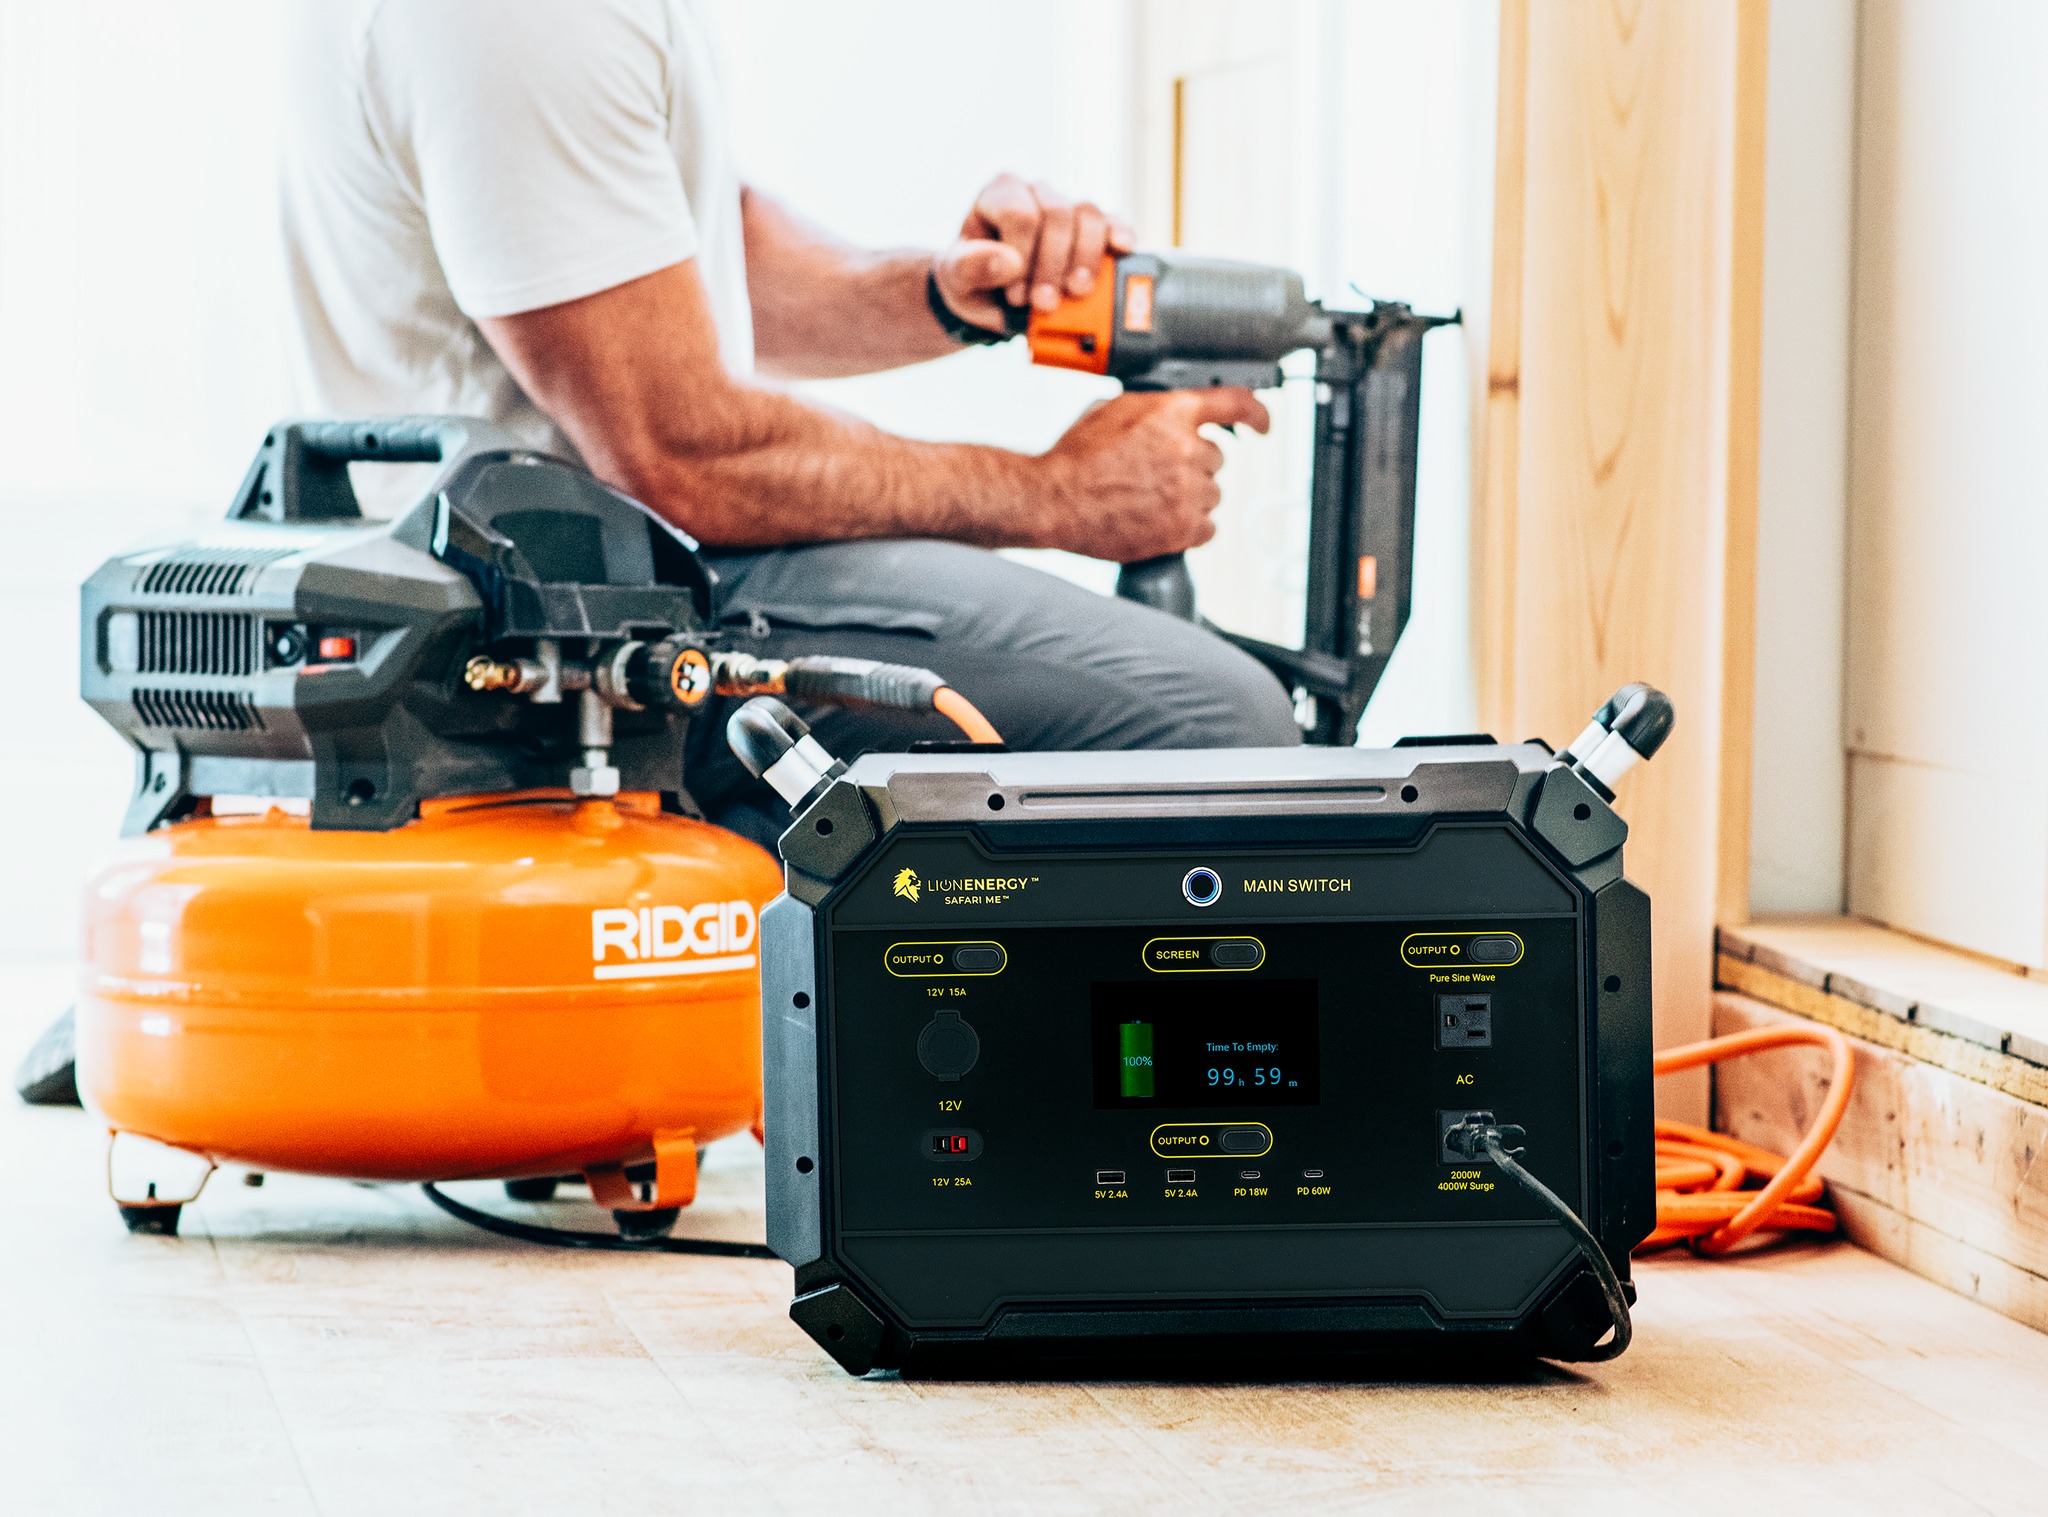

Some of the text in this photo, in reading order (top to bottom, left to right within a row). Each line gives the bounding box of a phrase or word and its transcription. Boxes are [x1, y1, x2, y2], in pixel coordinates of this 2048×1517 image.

[1243, 878, 1351, 893] MAIN SWITCH
[944, 895, 982, 905] SAFARI
[593, 901, 756, 961] RIDGID
[1156, 950, 1200, 960] SCREEN
[1407, 945, 1448, 955] OUTPUT
[892, 955, 932, 964] OUTPUT
[1429, 973, 1496, 983] Pure Sine Wave
[926, 987, 967, 997] 12V 15A
[1206, 1042, 1279, 1054] Time To Empty:
[1123, 1055, 1153, 1067] 100%
[1455, 1074, 1474, 1085] AC
[938, 1100, 963, 1111] 12V
[1157, 1136, 1197, 1146] OUTPUT
[1450, 1170, 1482, 1180] 2000W
[932, 1177, 972, 1187] 12V 25A
[1437, 1181, 1495, 1192] 4000W Surge
[1094, 1189, 1129, 1199] 5V 2.4A
[1164, 1188, 1199, 1198] 5V 2.4A
[1234, 1187, 1268, 1197] PD 18W
[1296, 1186, 1331, 1196] PD 60W
